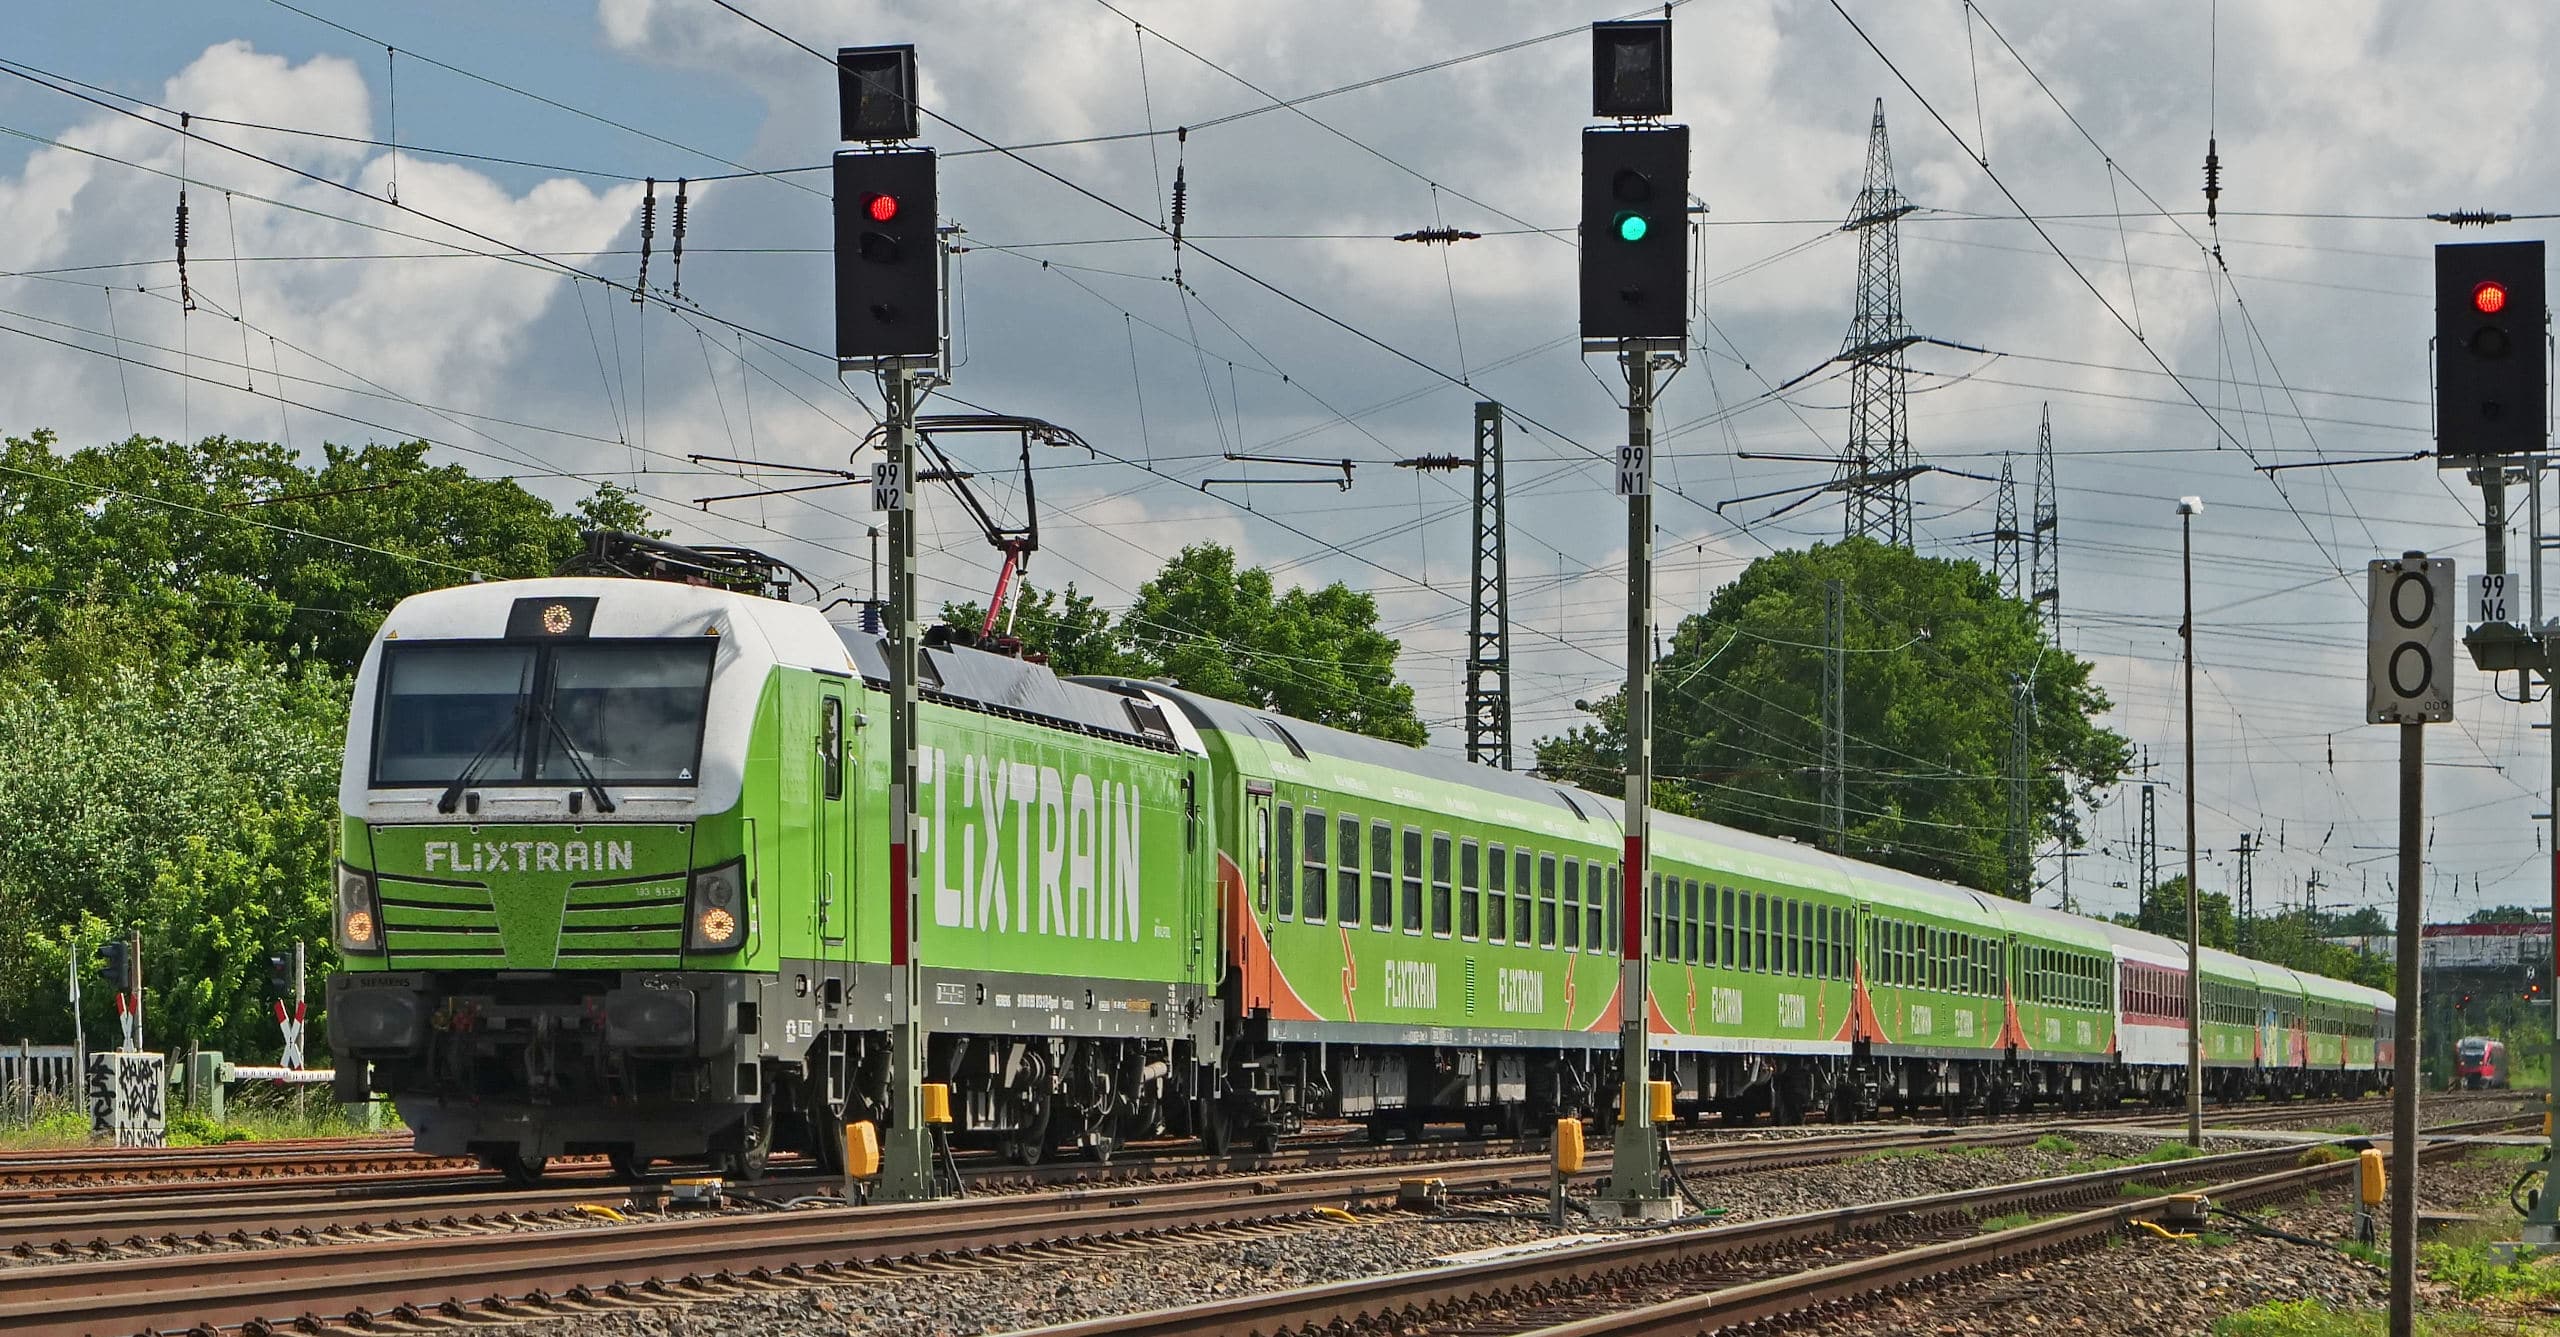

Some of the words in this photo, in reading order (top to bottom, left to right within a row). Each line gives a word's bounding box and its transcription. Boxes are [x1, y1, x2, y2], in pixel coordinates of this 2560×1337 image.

[1622, 447, 1644, 469] 99
[877, 464, 898, 486] 99
[1621, 471, 1644, 494] N1
[876, 488, 899, 510] N2
[2481, 575, 2505, 598] 99
[2481, 599, 2506, 621] N6
